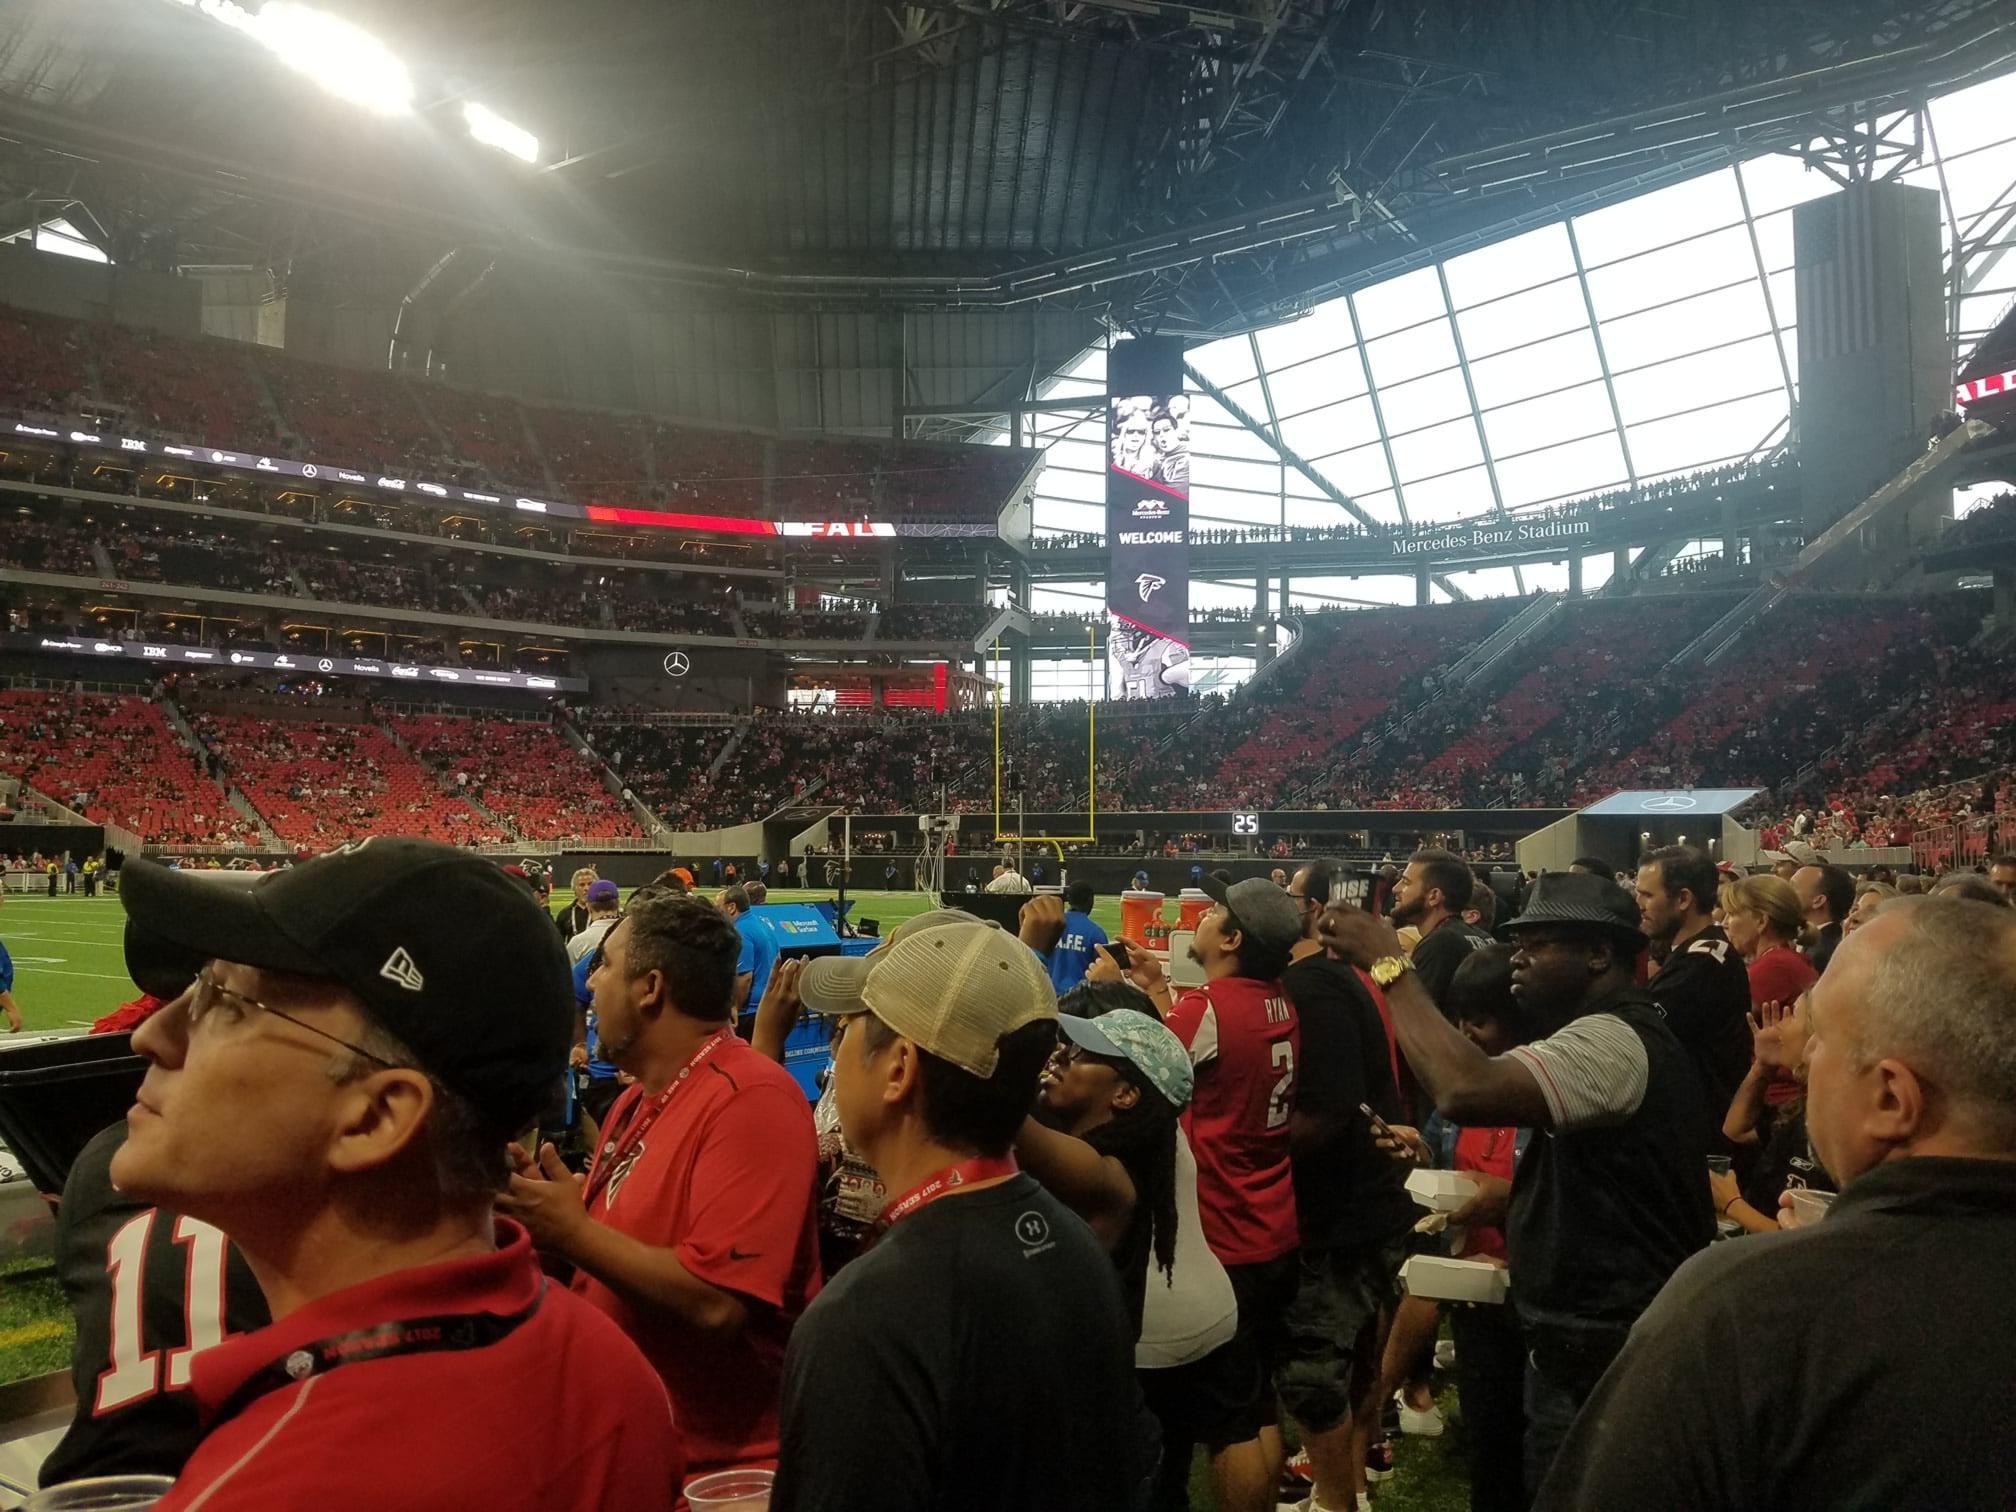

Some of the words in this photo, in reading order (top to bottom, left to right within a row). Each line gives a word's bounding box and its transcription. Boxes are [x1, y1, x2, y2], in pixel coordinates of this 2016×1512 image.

[121, 438, 147, 451] IBM
[1119, 531, 1183, 545] WELCOME
[1391, 530, 1513, 555] Mercedes-Benz
[1518, 520, 1590, 541] Stadium
[143, 646, 168, 658] IBM
[353, 664, 380, 673] Novelis
[1234, 814, 1257, 833] 25
[1055, 934, 1087, 952] A.F.E.
[1264, 997, 1290, 1024] RYAN
[1266, 1040, 1294, 1129] 2
[921, 1180, 943, 1198] 2017
[889, 1192, 921, 1221] SEASON
[92, 1207, 235, 1417] 11
